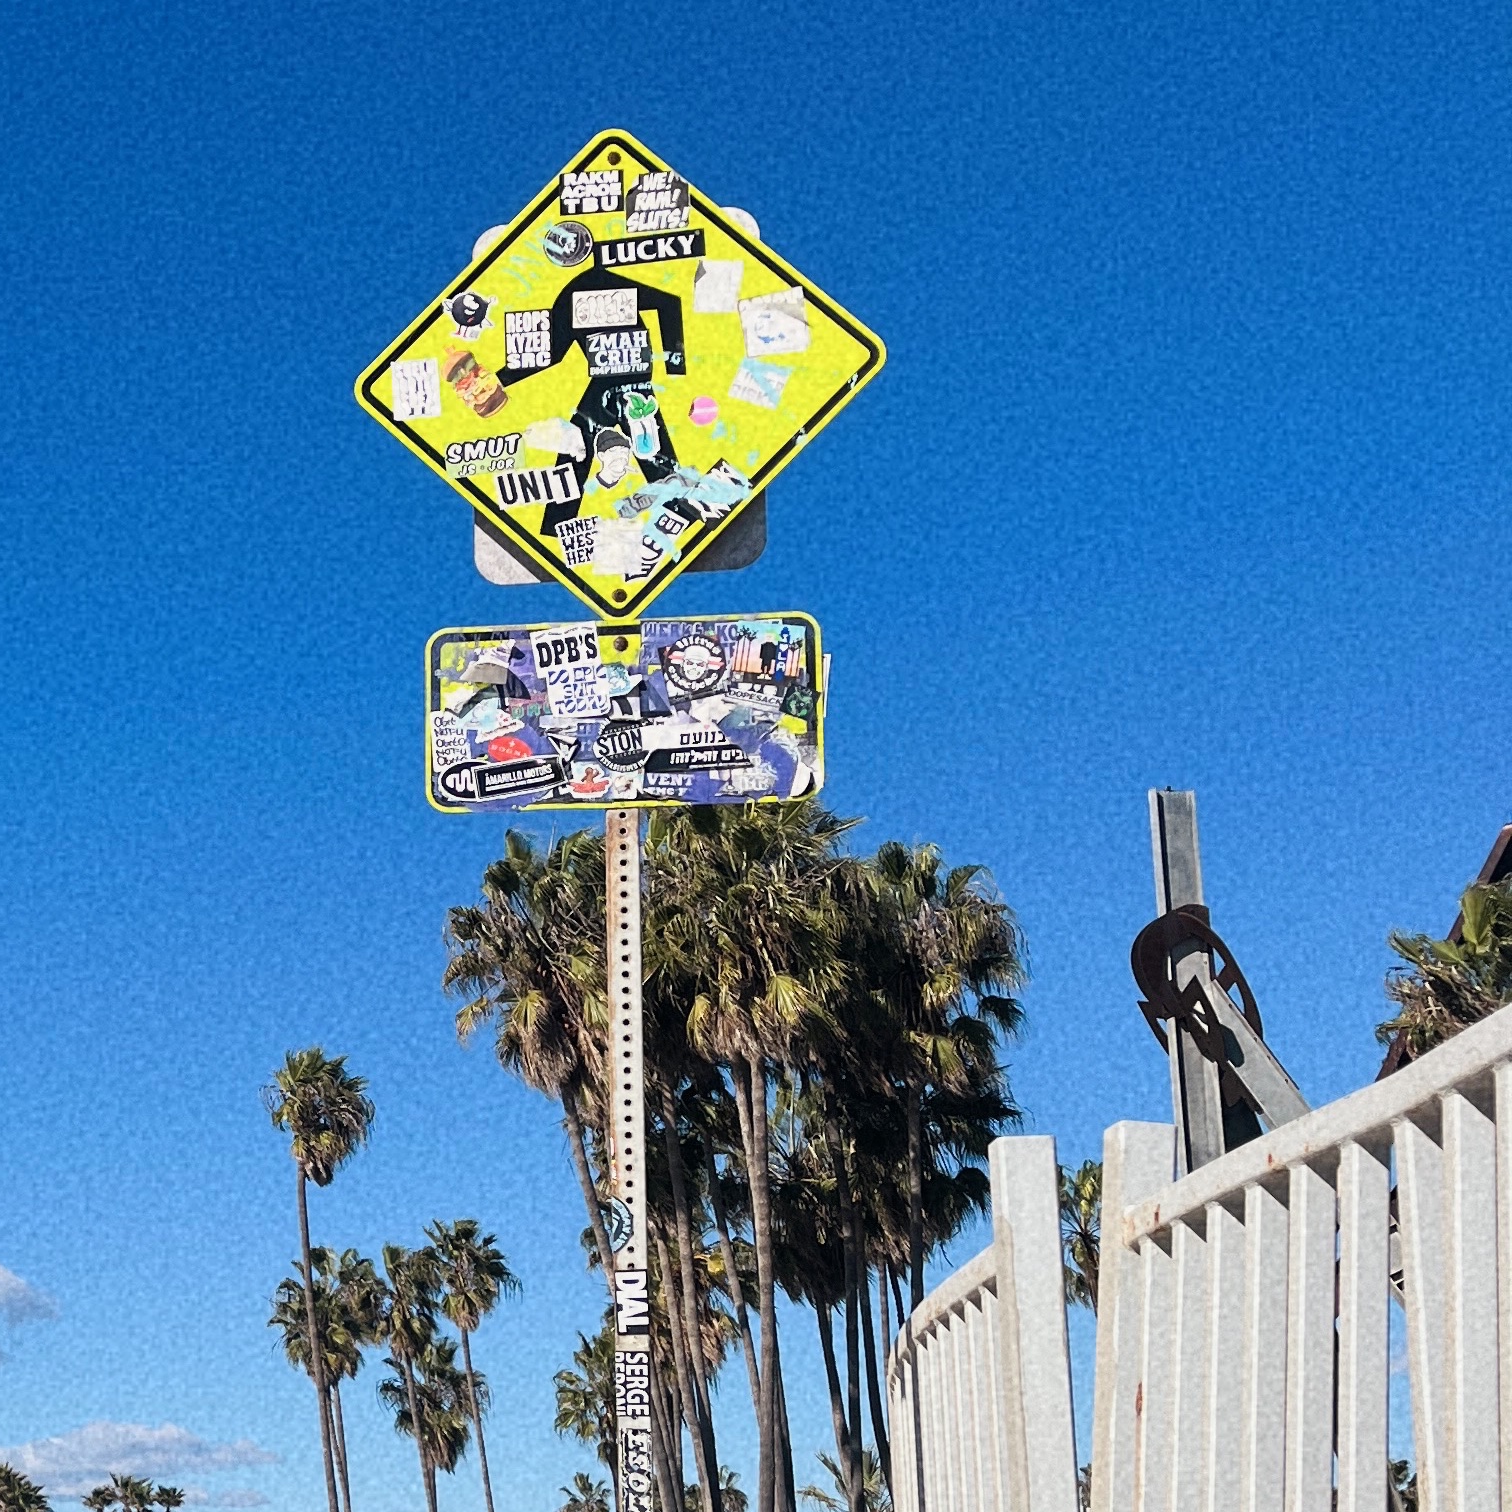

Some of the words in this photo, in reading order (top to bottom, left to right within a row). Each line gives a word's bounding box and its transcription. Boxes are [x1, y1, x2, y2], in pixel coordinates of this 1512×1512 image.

[564, 195, 619, 214] TBU
[626, 206, 690, 233] SLUTS!
[601, 234, 695, 265] LUCKY
[507, 352, 551, 370] SRC
[445, 432, 522, 464] SMUT
[497, 466, 571, 505] UNIT
[562, 530, 598, 551] WES
[536, 632, 598, 668] DPB'S
[615, 1271, 649, 1333] DIAL
[626, 1352, 650, 1416] SERGE
